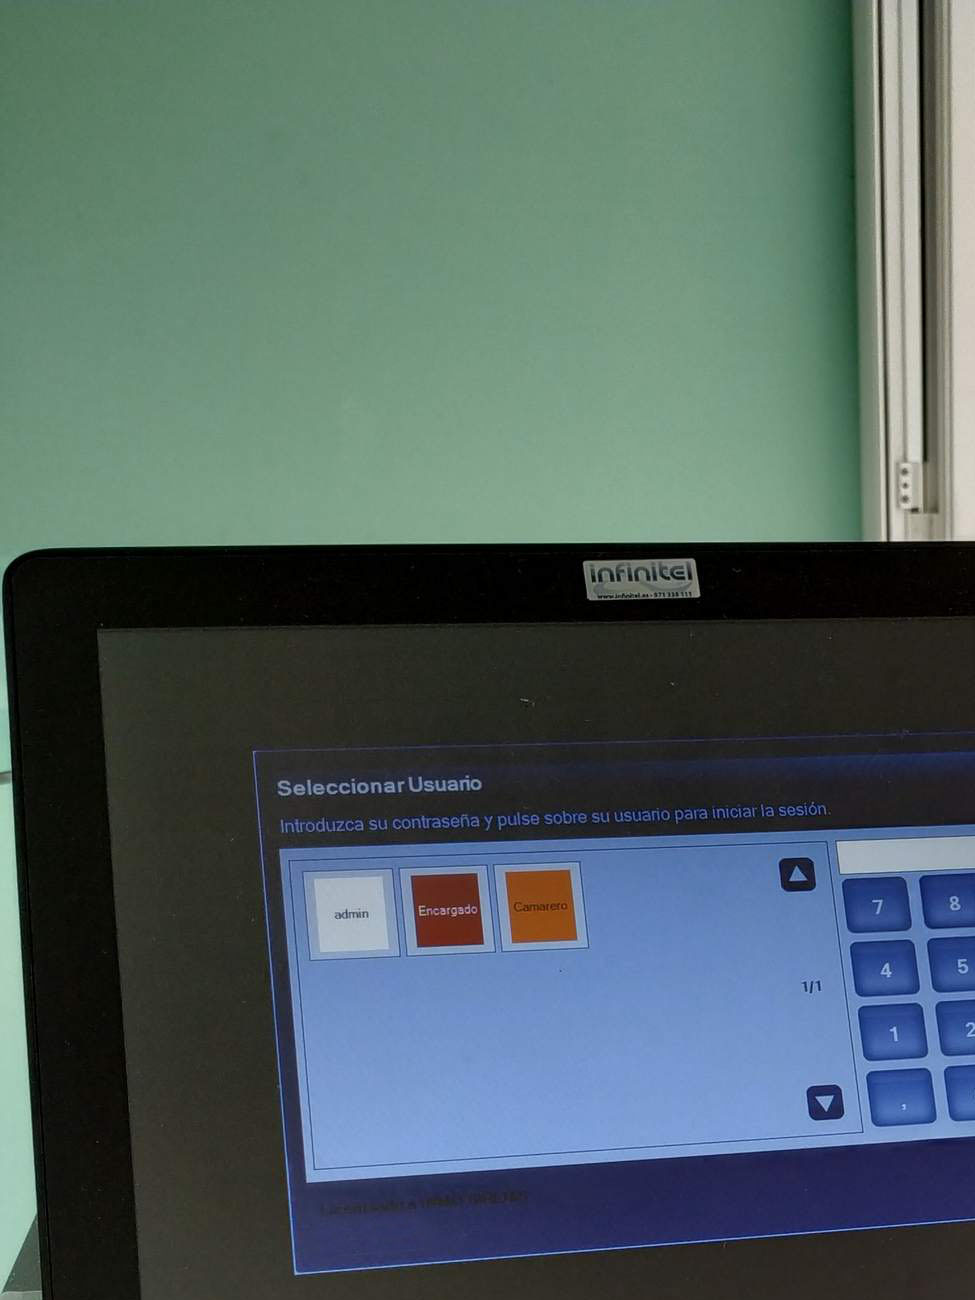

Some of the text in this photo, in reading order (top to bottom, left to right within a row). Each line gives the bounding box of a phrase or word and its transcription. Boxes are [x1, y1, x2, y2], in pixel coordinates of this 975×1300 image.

[590, 561, 693, 583] infinitel
[277, 775, 482, 797] Seleccionar Usuario
[280, 801, 832, 833] Introduzca su contraseña y pulse sobre su usuario para iniciar la sesión.
[418, 903, 478, 918] Encargado
[513, 899, 568, 913] Camarero
[872, 900, 884, 914] 7
[949, 896, 961, 911] 8
[334, 908, 369, 921] admin
[880, 962, 892, 978] 4
[957, 959, 969, 974] 5
[801, 980, 822, 994] 1/1
[889, 1026, 899, 1042] 1
